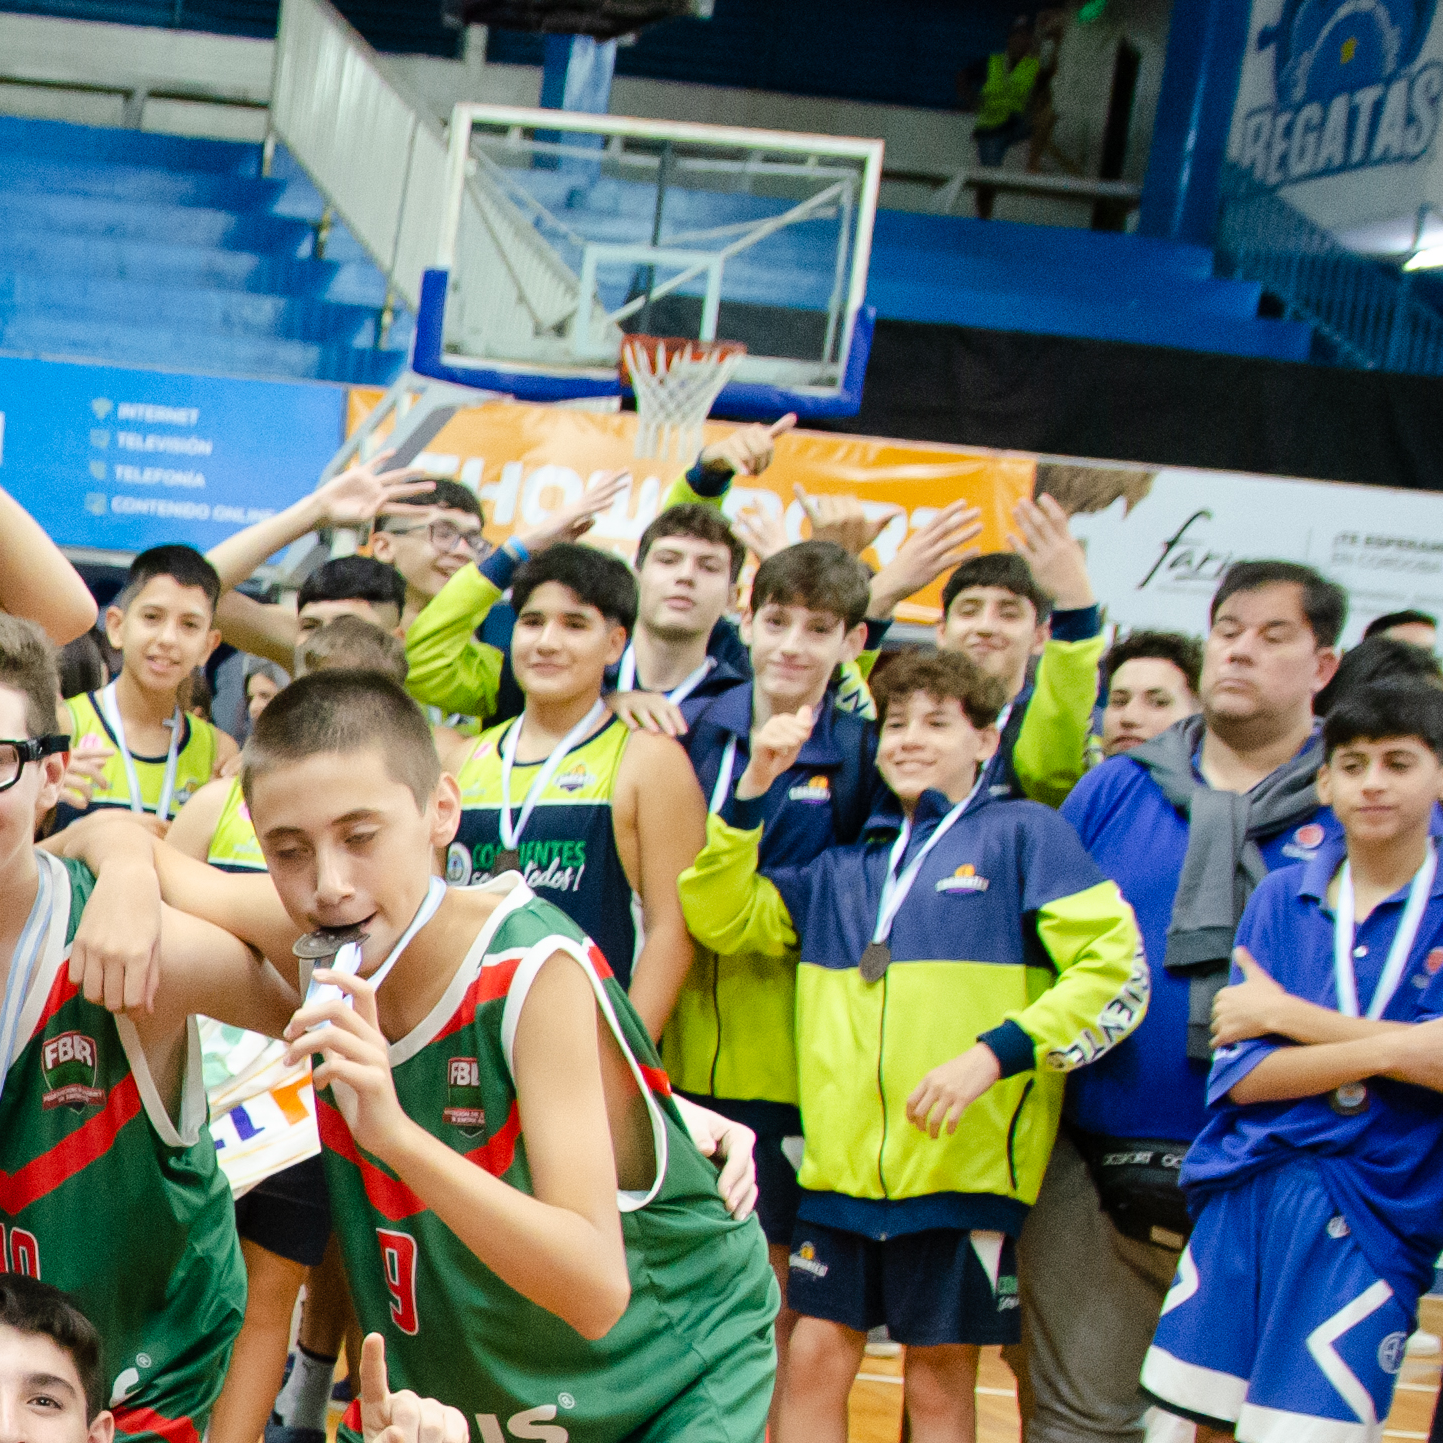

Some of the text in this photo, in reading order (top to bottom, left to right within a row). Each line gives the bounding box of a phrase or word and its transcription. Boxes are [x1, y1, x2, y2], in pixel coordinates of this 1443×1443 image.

[1226, 60, 1443, 186] REGATAS
[117, 402, 199, 427] INTERNET
[375, 1227, 419, 1336] 9
